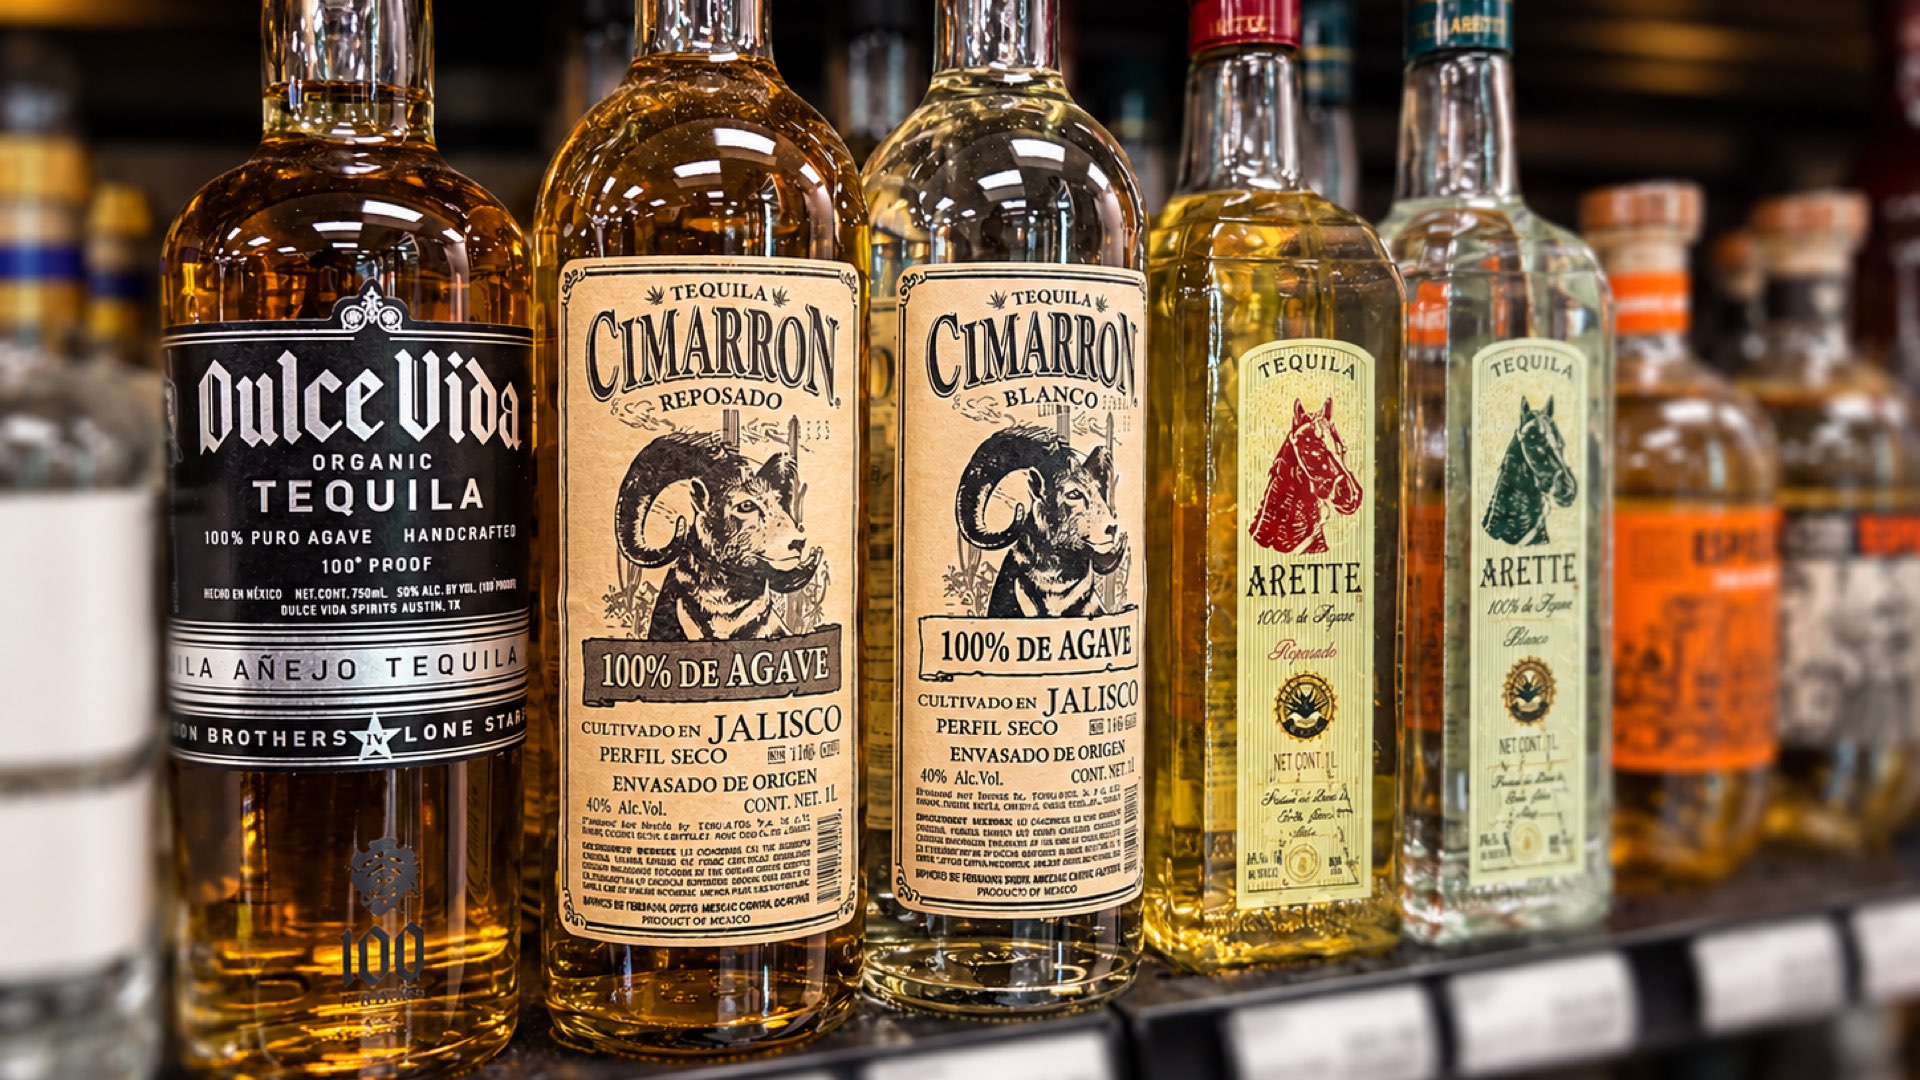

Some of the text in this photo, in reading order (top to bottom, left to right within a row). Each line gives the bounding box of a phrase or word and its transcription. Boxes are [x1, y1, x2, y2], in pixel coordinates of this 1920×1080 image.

[670, 282, 768, 302] TEQUILA
[1012, 289, 1092, 309] TEQUILA
[585, 304, 840, 406] CIMARRON
[926, 310, 1138, 402] CIMARRON
[1258, 353, 1356, 381] TEQUILA
[1490, 354, 1573, 379] TEQUILA
[198, 349, 522, 455] Dulce Vida
[659, 386, 783, 412] REPOSADO
[1003, 385, 1099, 409] BLANCO
[312, 453, 433, 471] ORGANIC
[252, 478, 485, 516] TEQUILA
[205, 524, 516, 545] 100% PURO AGAVE HANDCRAFTED
[369, 556, 432, 573] PROOF
[1480, 553, 1577, 588] ARETTE
[422, 584, 444, 597] ALC.
[1246, 562, 1363, 598] ARETTE
[246, 585, 283, 600] MÉXICO
[280, 603, 317, 616] DULCE
[320, 603, 347, 615] VIDA
[350, 601, 397, 615] SPIRITS
[448, 599, 461, 610] TX
[1257, 608, 1293, 626] 100%
[1488, 596, 1518, 615] 100%
[941, 624, 1132, 663] 100% DE AGAVE
[233, 654, 356, 681] AÑEJO
[386, 645, 517, 678] TEQUILA
[601, 645, 830, 689] 100% DE AGAVE
[917, 678, 1139, 717] CULTIVADO EN JALISCO
[206, 727, 347, 748] BROTHERS
[404, 719, 473, 742] LONE
[581, 703, 842, 745] CULTIVADO EN JALISCO
[936, 717, 1001, 736] PERFIL
[1007, 719, 1058, 736] SECO
[600, 745, 664, 765] PERFIL
[671, 747, 728, 765] SECO
[950, 739, 1126, 764] ENVASADO DE ORIGEN
[1499, 738, 1516, 756] NET
[1273, 752, 1293, 772] NET
[612, 767, 818, 794] ENVASADO DE ORIGEN
[920, 768, 947, 784] 40%
[1071, 765, 1107, 784] CONT.
[586, 796, 612, 814] 40%
[743, 795, 791, 814] CONT.
[794, 790, 822, 808] NET.
[641, 914, 690, 926] PRODUCT
[342, 921, 425, 987] 100
